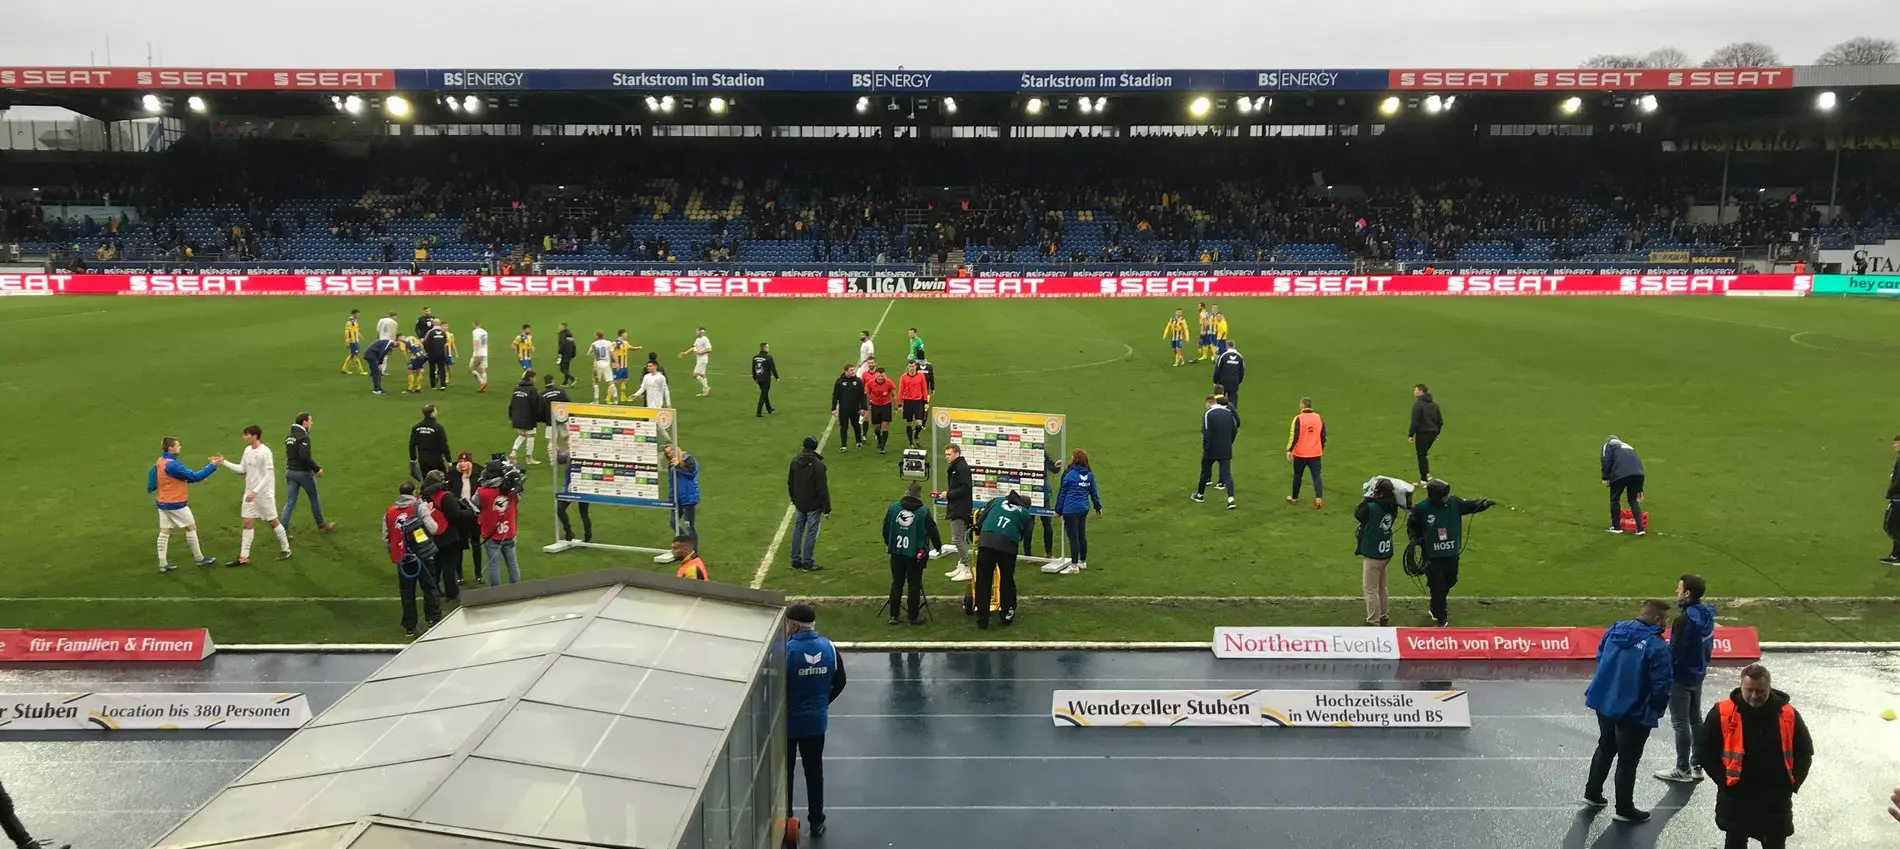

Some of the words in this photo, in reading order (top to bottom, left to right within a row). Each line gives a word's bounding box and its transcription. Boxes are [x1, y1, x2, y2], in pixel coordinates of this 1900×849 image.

[22, 71, 112, 85] SEAT
[159, 71, 248, 85] SEAT
[295, 72, 383, 86] SEAT
[613, 72, 688, 86] Starkstrom
[692, 73, 709, 86] im
[712, 73, 765, 86] Stadion
[1020, 74, 1096, 88] Starkstrom
[1099, 74, 1116, 87] im
[1119, 73, 1172, 87] Stadion
[1422, 73, 1509, 86] SEAT
[1555, 73, 1643, 86] SEAT
[1690, 72, 1782, 86] SEAT
[150, 276, 249, 291] SEAT
[325, 276, 423, 291] SEAT
[499, 277, 598, 292] SEAT
[674, 278, 772, 293] SEAT
[847, 278, 864, 293] 3.
[866, 278, 908, 293] LIGA
[912, 278, 946, 290] bwin
[948, 278, 1045, 293] SEAT
[1120, 278, 1218, 293] SEAT
[1293, 277, 1392, 292] SEAT
[1467, 276, 1566, 291] SEAT
[1640, 276, 1738, 291] SEAT
[1849, 277, 1876, 291] hey
[996, 515, 1011, 529] 17
[896, 535, 909, 549] 20
[1378, 540, 1391, 553] 09
[1433, 540, 1455, 551] HOST
[30, 637, 53, 652] für
[56, 637, 120, 652] Familien
[124, 638, 137, 651] &
[141, 637, 193, 652] Firmen
[1223, 633, 1328, 653] Northern
[1333, 635, 1392, 653] Events
[1407, 636, 1458, 650] Verleih
[1463, 640, 1489, 650] von
[1494, 635, 1537, 654] Party-
[1541, 637, 1569, 650] und
[798, 666, 828, 676] erima
[1068, 699, 1181, 715] Wendezeller
[1187, 699, 1250, 715] Stuben
[1316, 693, 1414, 707] Hochzeitssäle
[12, 703, 78, 719] Stuben
[102, 704, 165, 718] Location
[169, 704, 190, 718] bis
[193, 704, 222, 717] 380
[226, 704, 290, 718] Personen
[1289, 709, 1302, 722] in
[1306, 709, 1389, 726] Wendeburg
[1394, 709, 1421, 723] und
[1426, 710, 1443, 723] BS
